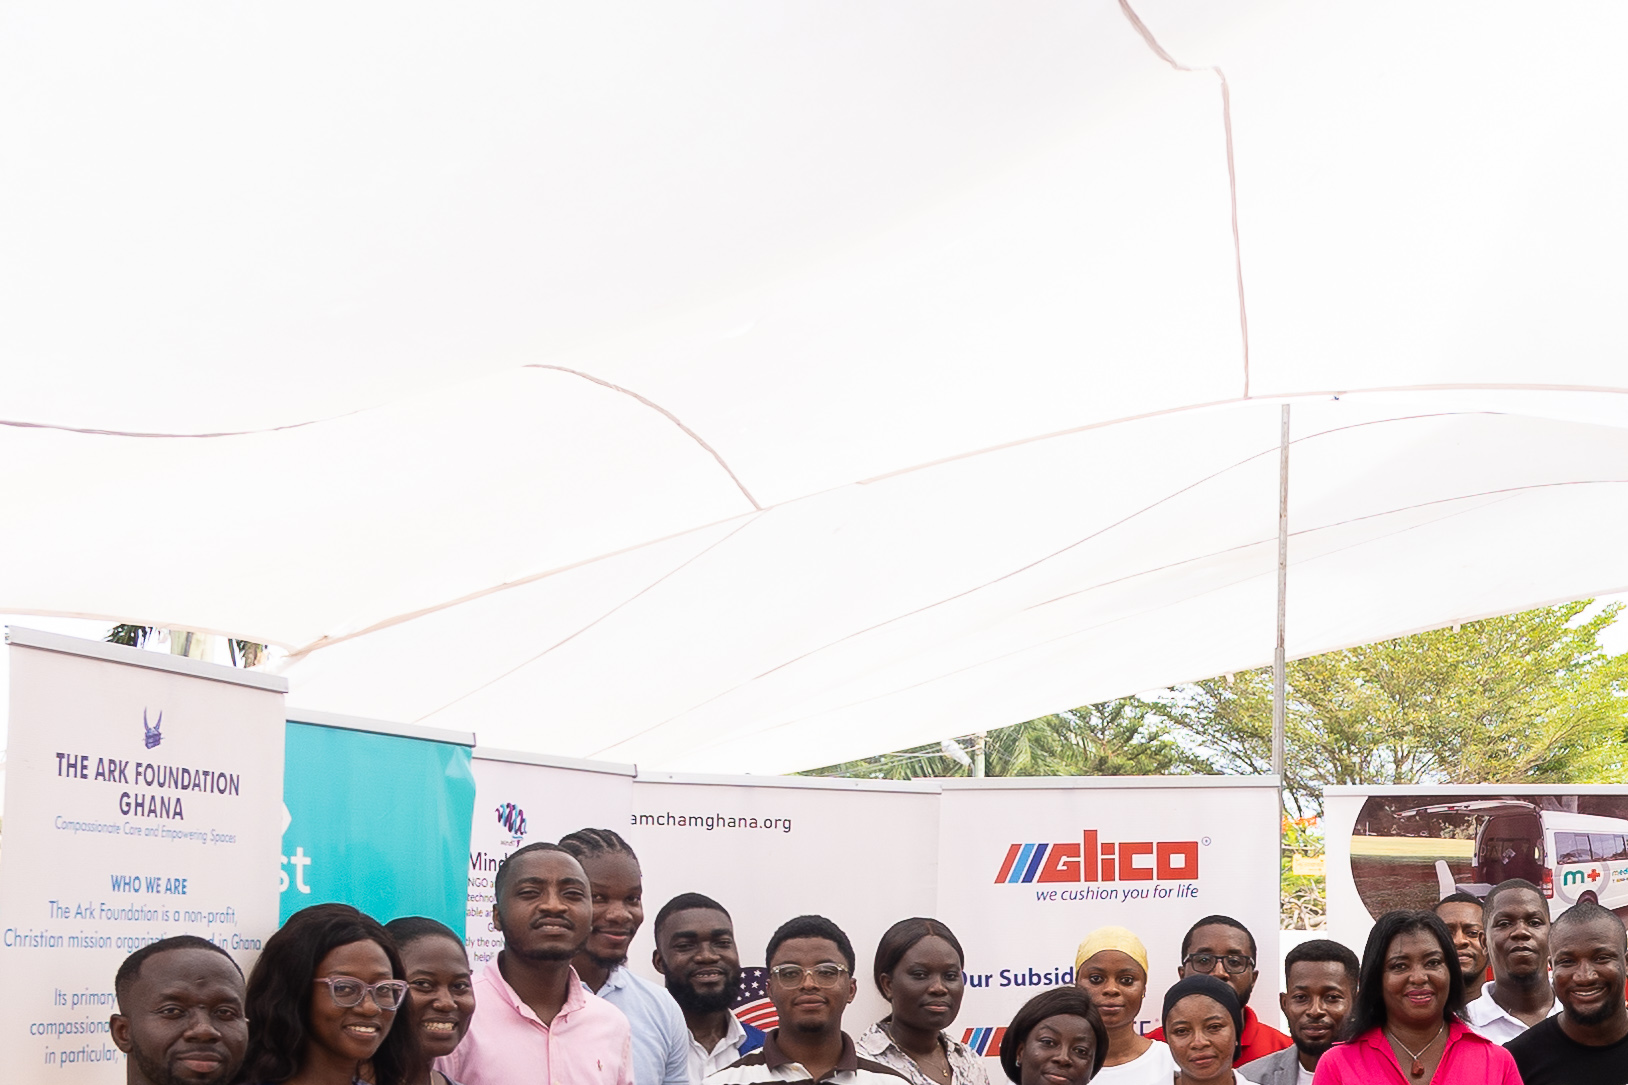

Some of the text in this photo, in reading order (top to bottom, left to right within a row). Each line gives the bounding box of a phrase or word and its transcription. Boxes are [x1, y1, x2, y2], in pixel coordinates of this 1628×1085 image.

[56, 752, 240, 796] THE ARK FOUNDATION
[119, 791, 185, 821] GHANA
[55, 815, 237, 845] Compassionate Care and Empowering Spaces
[630, 811, 793, 834] amchamghana.org
[111, 874, 188, 895] WHO WE ARE
[1036, 883, 1200, 904] we cushion you for life
[49, 901, 71, 919] The
[74, 902, 96, 921] Ark
[99, 903, 159, 922] Foundation
[161, 905, 170, 922] is
[173, 911, 181, 922] a
[4, 928, 64, 949] Christian
[68, 931, 113, 949] mission
[54, 988, 117, 1011] Its primary
[44, 1043, 119, 1068] in particular,
